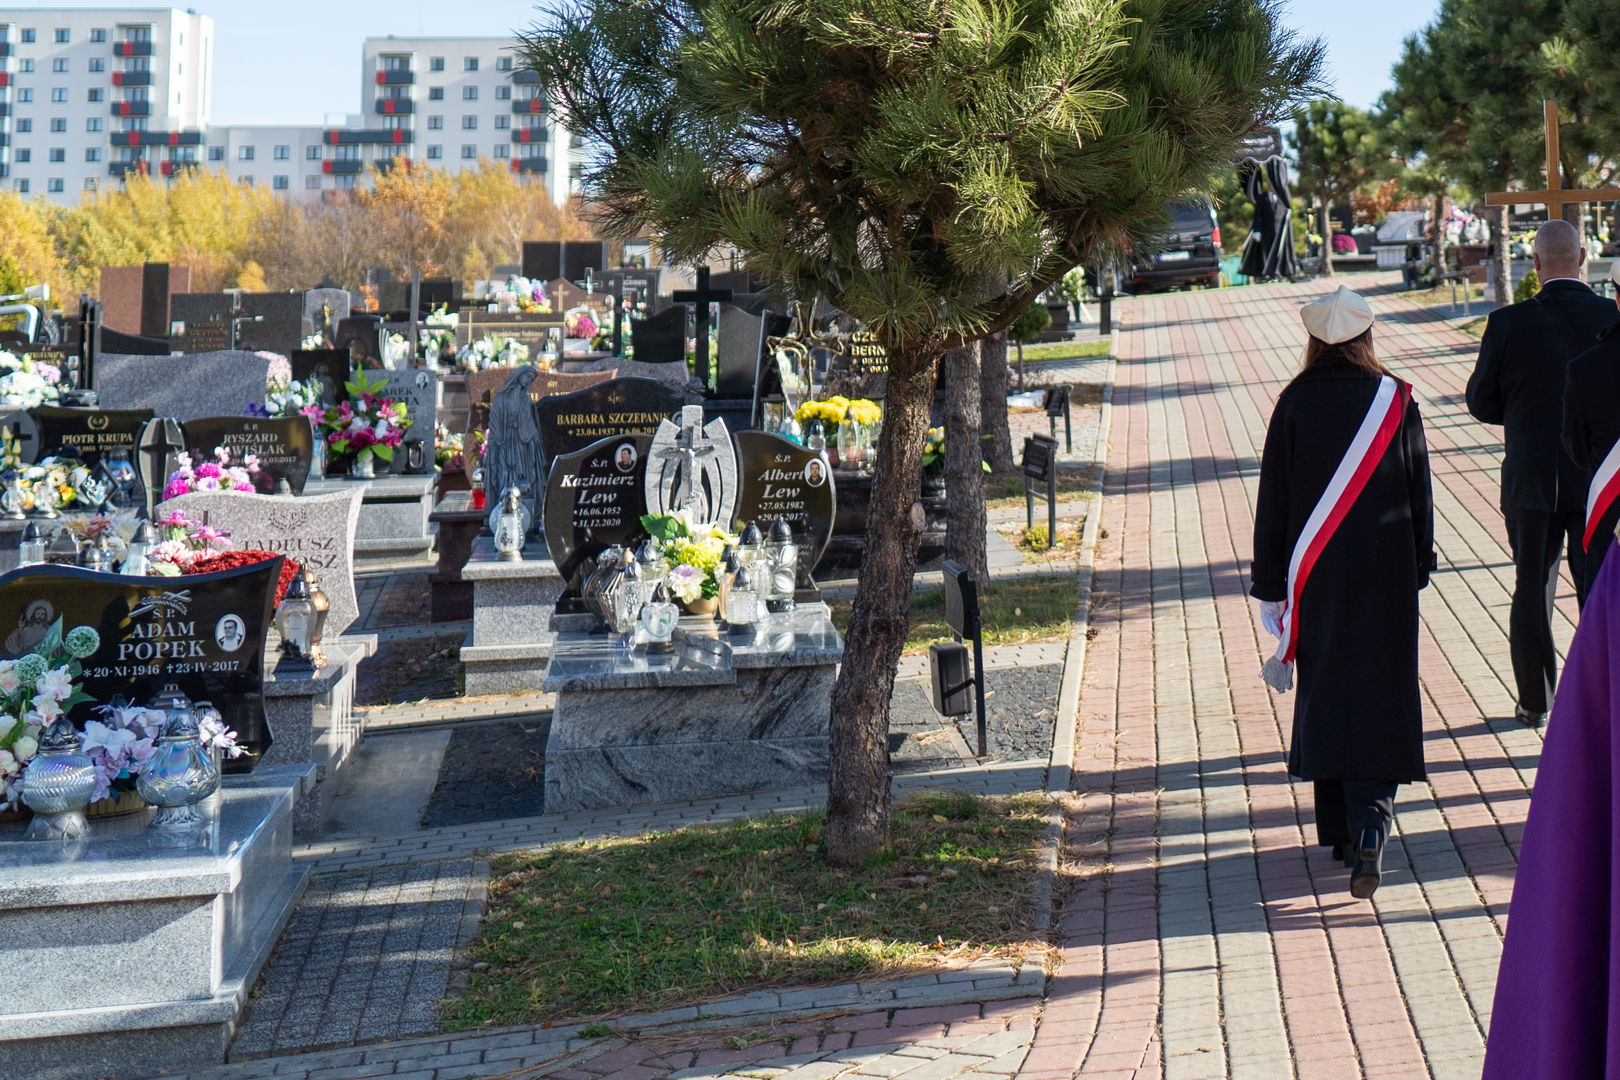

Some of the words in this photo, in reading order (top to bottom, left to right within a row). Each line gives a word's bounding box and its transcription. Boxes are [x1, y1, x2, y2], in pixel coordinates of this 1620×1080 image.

[851, 344, 886, 357] BERN
[556, 413, 605, 426] BARBARA
[62, 433, 95, 445] PIOTR
[97, 432, 134, 443] KRUPA
[223, 432, 279, 444] RYSZARD
[560, 472, 635, 488] Kazimierz
[757, 468, 804, 481] Albert
[577, 489, 617, 504] Lew
[762, 484, 801, 499] Lew
[240, 537, 335, 552] TADEUSZ
[131, 620, 197, 639] ADAM
[117, 639, 207, 661] POPEK
